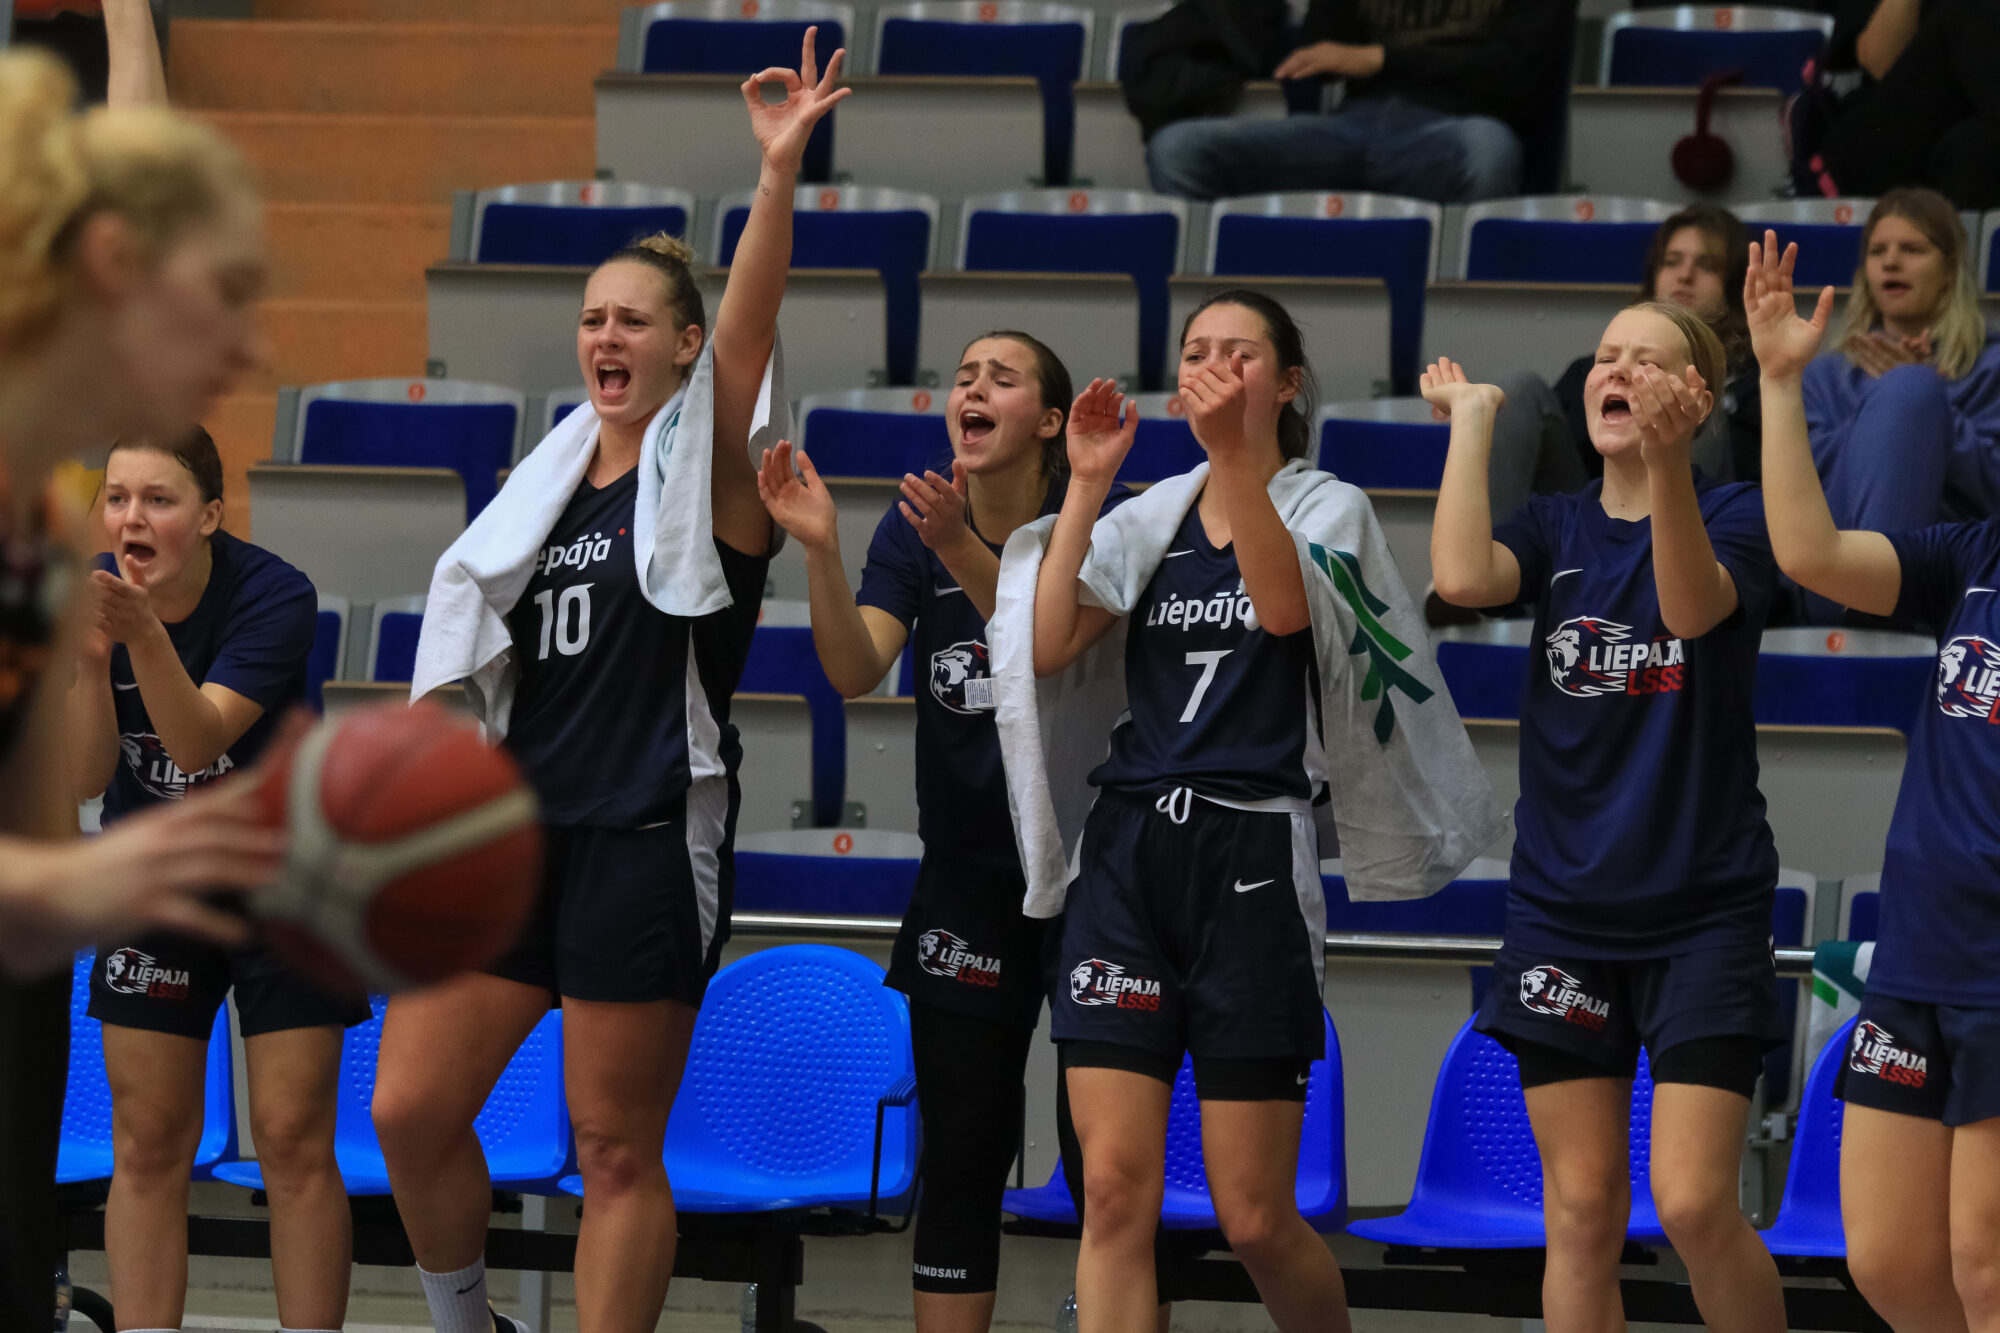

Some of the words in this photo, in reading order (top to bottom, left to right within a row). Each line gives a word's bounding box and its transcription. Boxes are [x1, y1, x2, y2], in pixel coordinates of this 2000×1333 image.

[534, 583, 595, 661] 10
[1179, 650, 1235, 723] 7
[1627, 664, 1685, 695] LSSS
[1964, 666, 2000, 698] LIE
[150, 753, 235, 784] LIEA
[1117, 993, 1161, 1012] LSSS
[1879, 1062, 1926, 1088] LSSS
